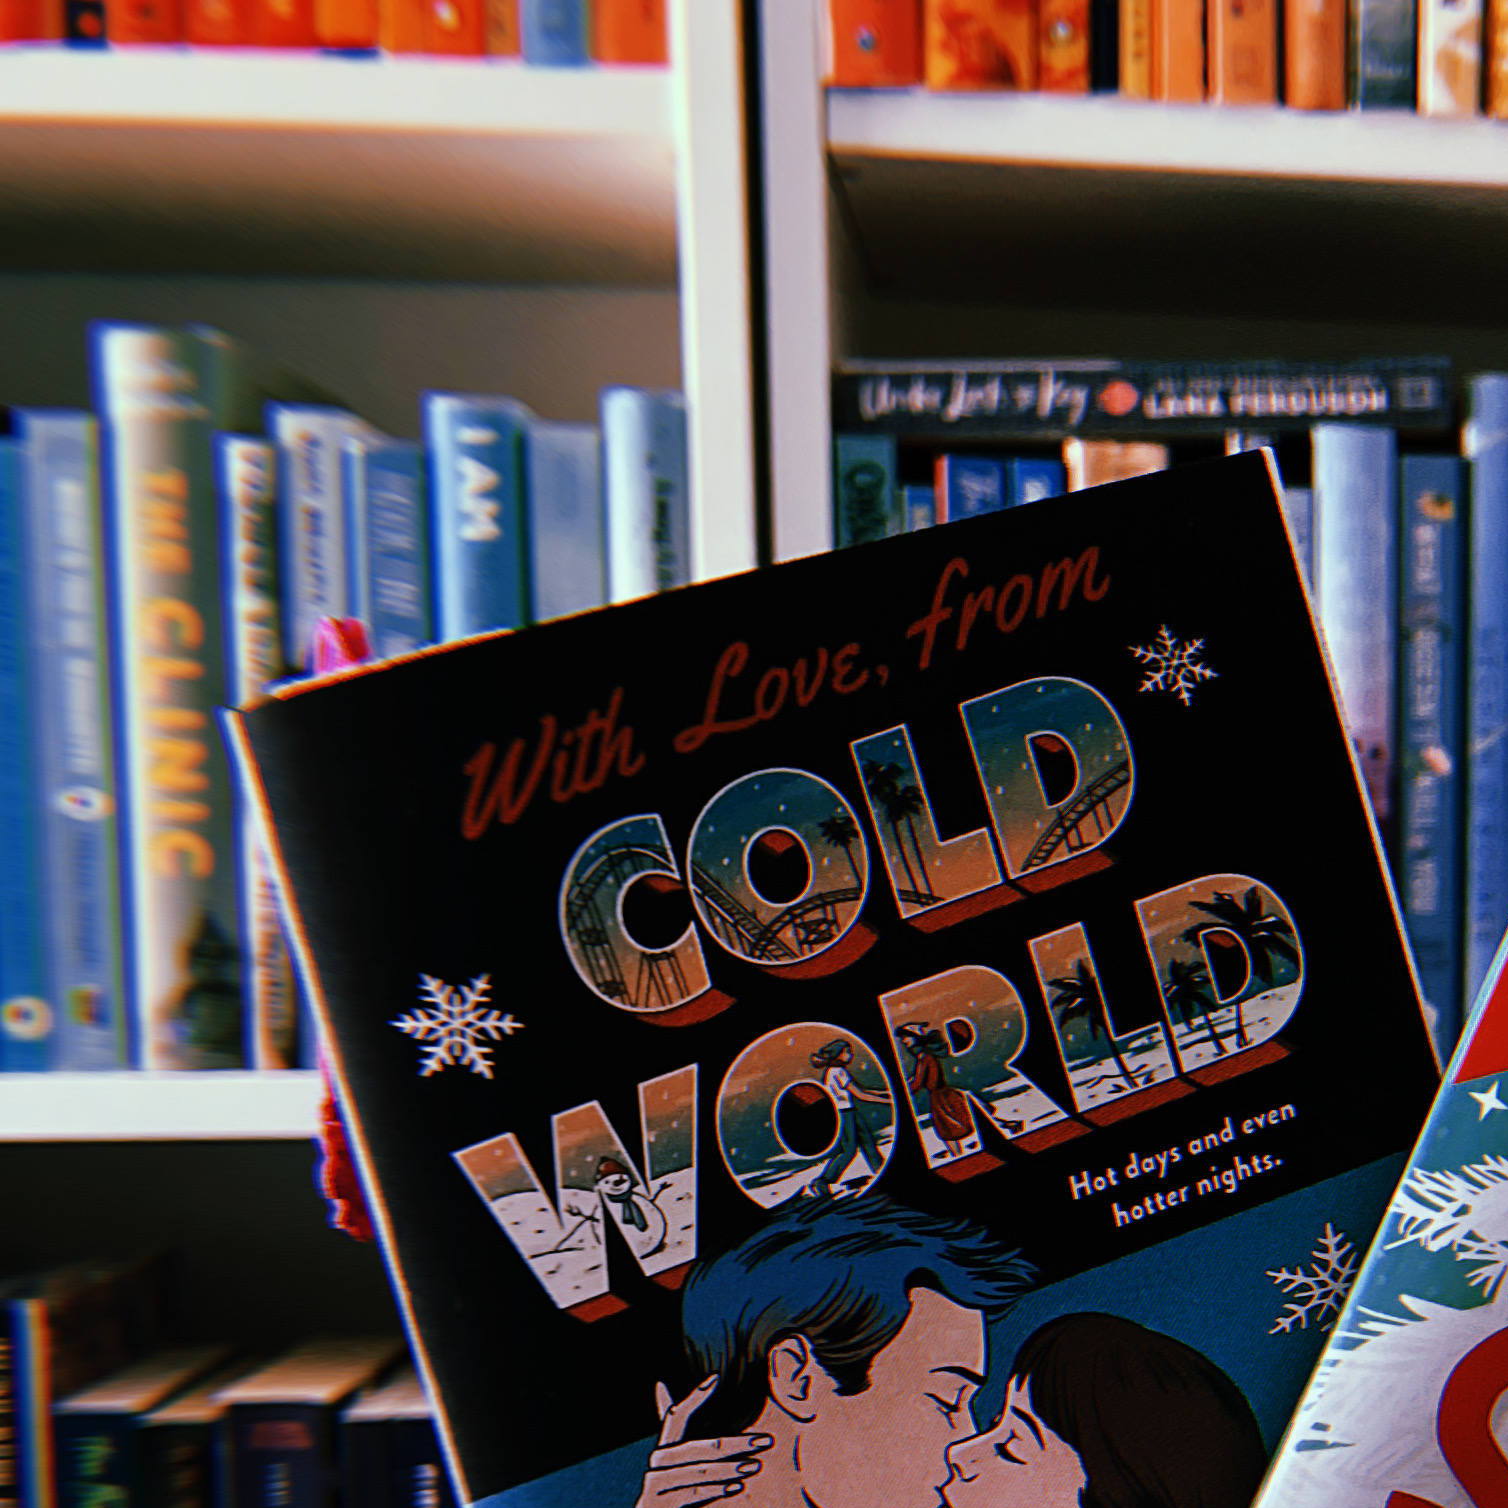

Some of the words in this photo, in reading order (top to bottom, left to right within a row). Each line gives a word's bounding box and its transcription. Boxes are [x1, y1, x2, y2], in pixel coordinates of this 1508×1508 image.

[141, 598, 215, 880] CLINIC
[461, 688, 644, 842] With
[673, 640, 893, 755] Love,
[907, 546, 1111, 669] from
[558, 675, 1136, 1028] COLD
[451, 873, 1306, 1322] WORLD
[1068, 1167, 1120, 1200] Hot
[1124, 1146, 1183, 1179] days
[1187, 1116, 1238, 1156] and
[1241, 1103, 1298, 1135] even
[1110, 1185, 1191, 1229] hotter
[1195, 1154, 1285, 1194] nights.
